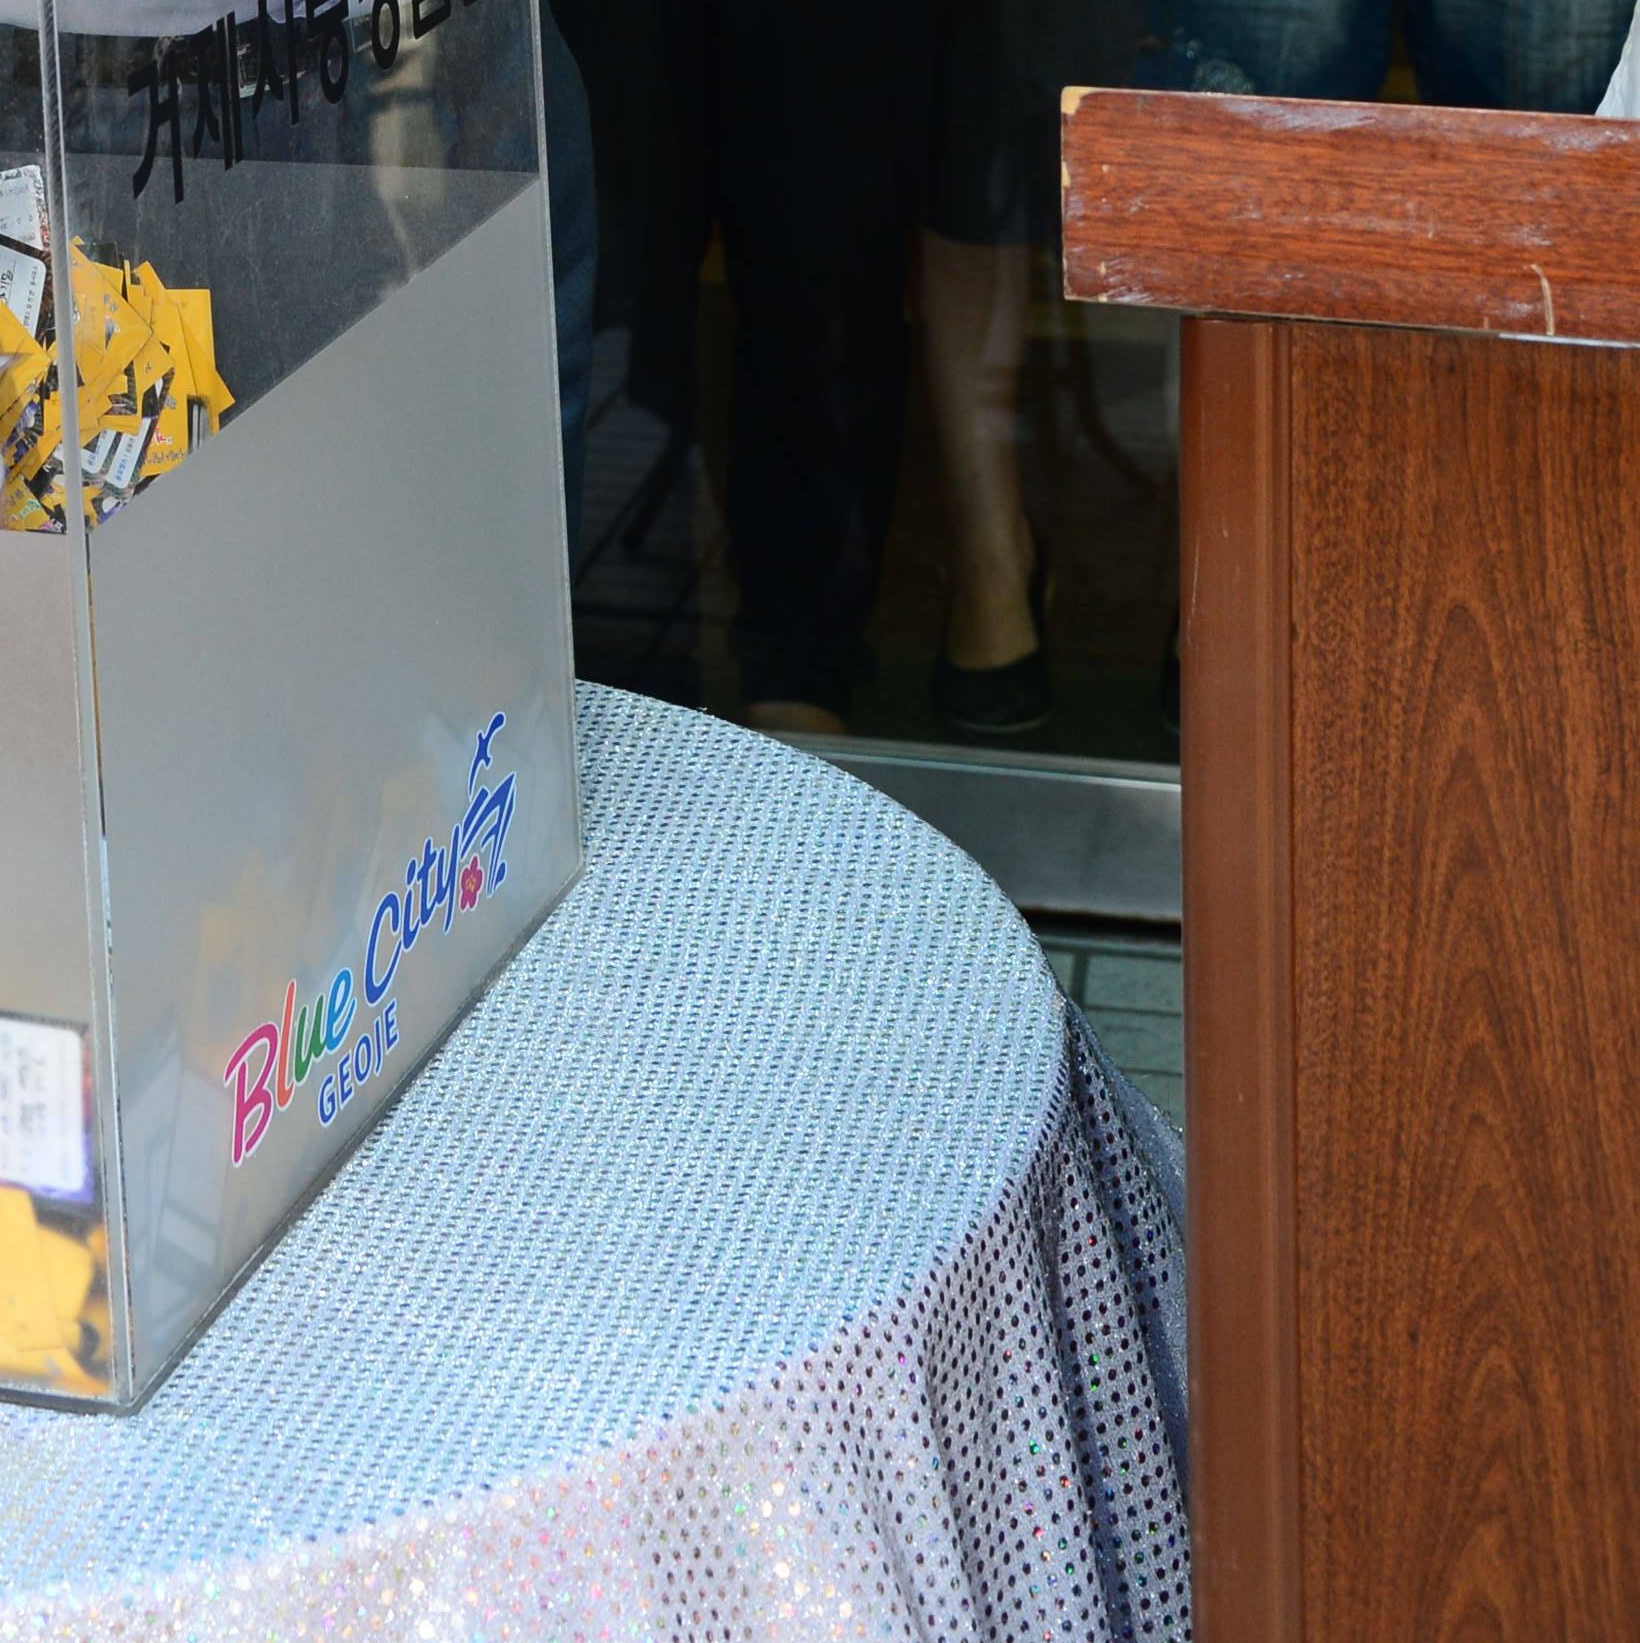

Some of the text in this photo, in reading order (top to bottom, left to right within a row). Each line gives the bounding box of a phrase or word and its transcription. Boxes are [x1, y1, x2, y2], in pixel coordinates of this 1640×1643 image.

[224, 823, 462, 1168] Blue City
[318, 999, 400, 1126] GEOJE
